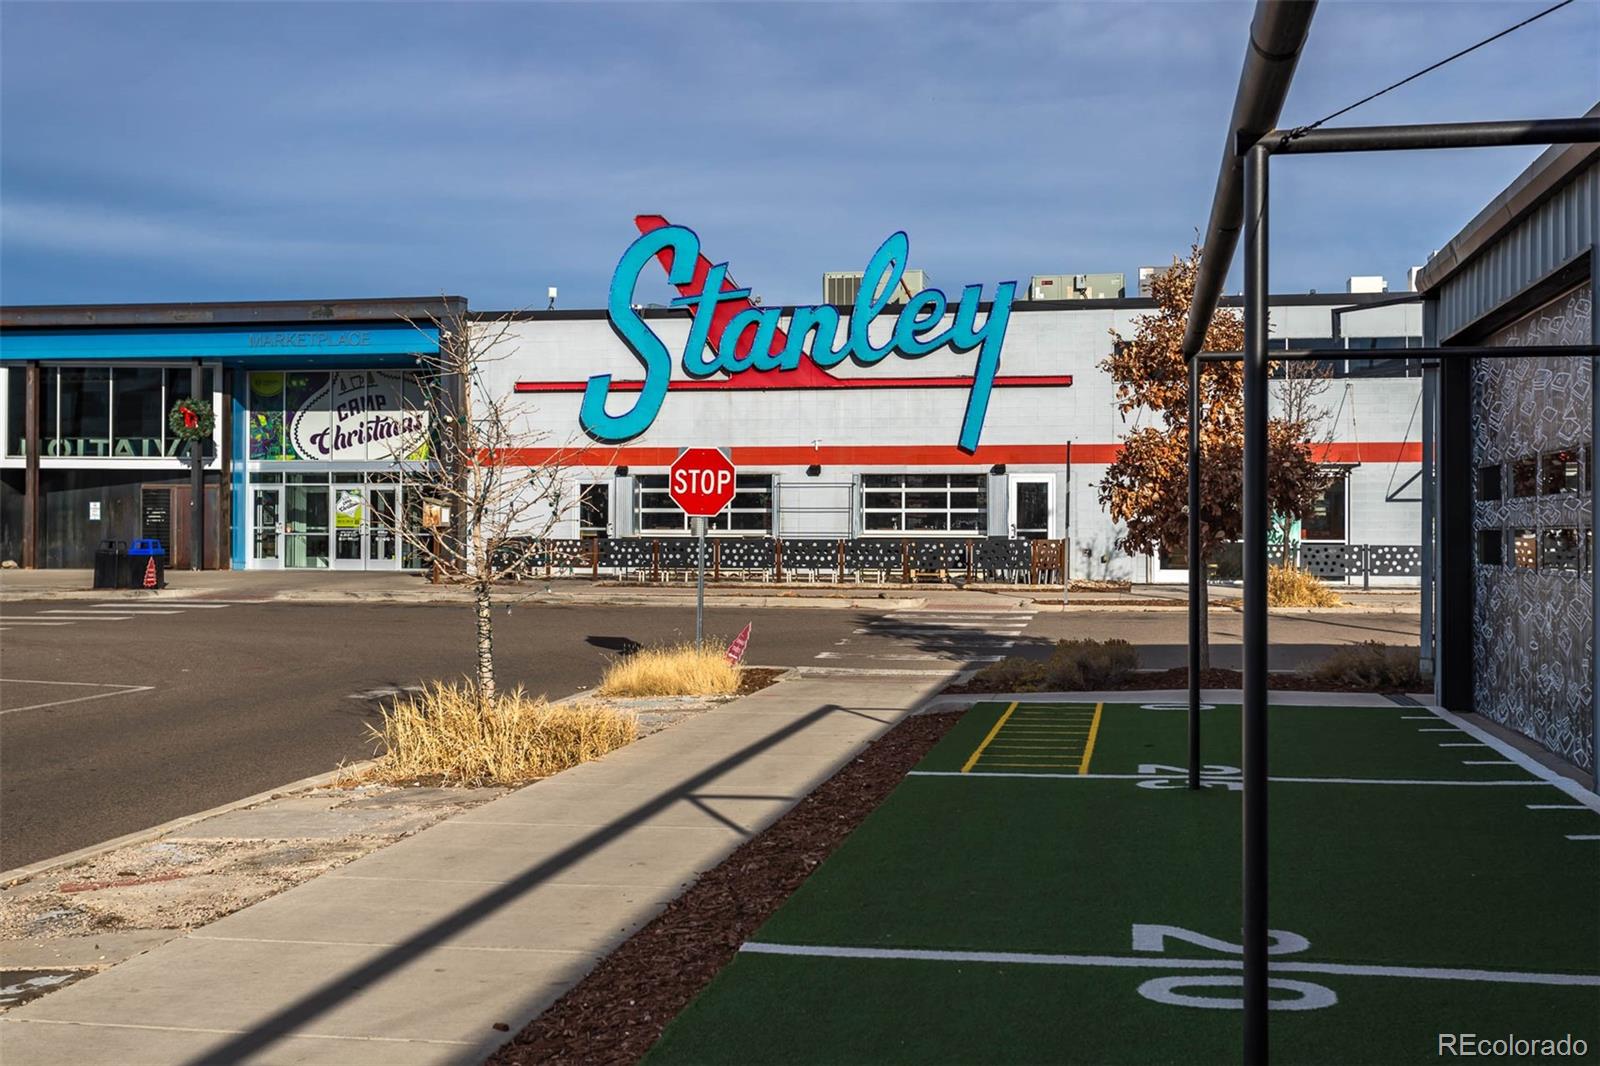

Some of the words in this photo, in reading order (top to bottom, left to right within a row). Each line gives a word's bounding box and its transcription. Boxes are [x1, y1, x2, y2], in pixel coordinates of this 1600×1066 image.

[248, 331, 371, 348] MARKETPLACE
[579, 224, 1018, 455] Stanley
[337, 394, 387, 422] CAMP
[309, 414, 423, 455] Christmas
[673, 468, 731, 495] STOP
